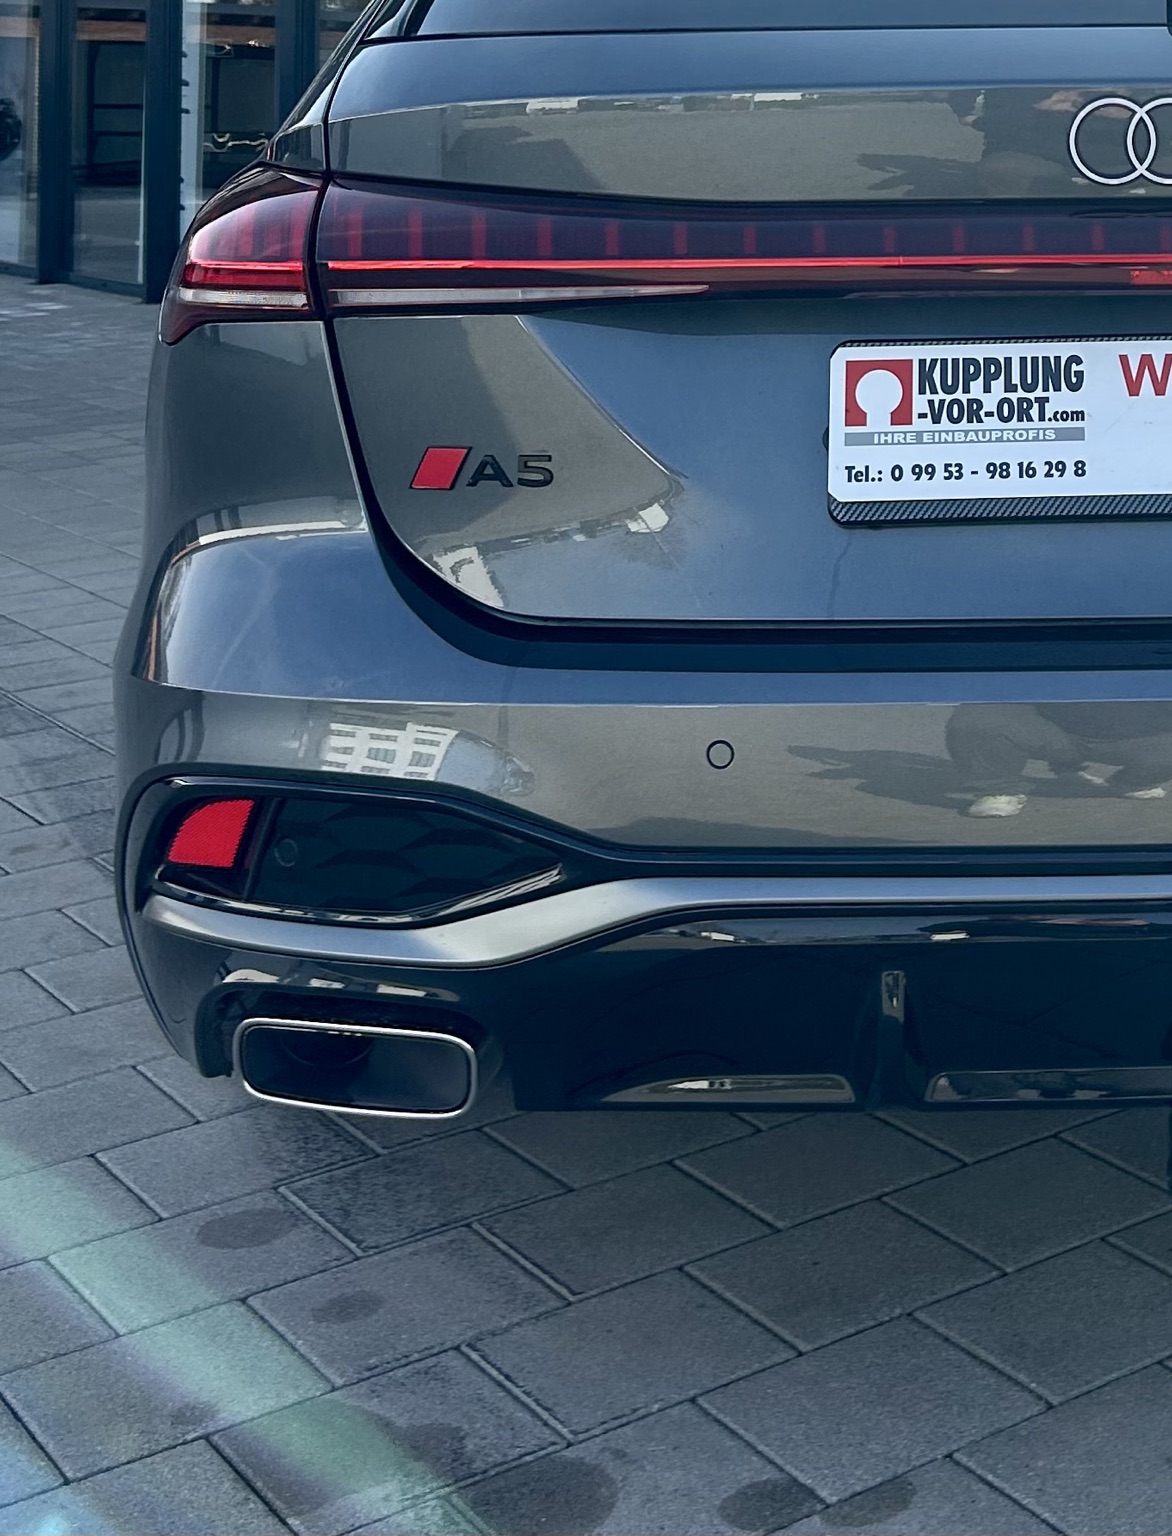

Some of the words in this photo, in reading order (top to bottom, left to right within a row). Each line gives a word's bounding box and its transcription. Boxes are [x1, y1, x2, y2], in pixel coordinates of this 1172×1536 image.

[918, 355, 1084, 395] KUPPLUNG
[918, 397, 1085, 424] -VOR-ORT.com
[873, 432, 917, 444] IHRE
[922, 429, 1056, 443] EINBAUPROFIS
[466, 454, 554, 487] A5
[845, 465, 883, 482] Tel.:
[890, 464, 903, 481] 0
[911, 463, 936, 481] 99
[943, 463, 964, 480] 53
[986, 462, 1011, 479] 98
[1018, 461, 1037, 478] 16
[1044, 460, 1067, 478] 29
[1074, 460, 1086, 477] 8
